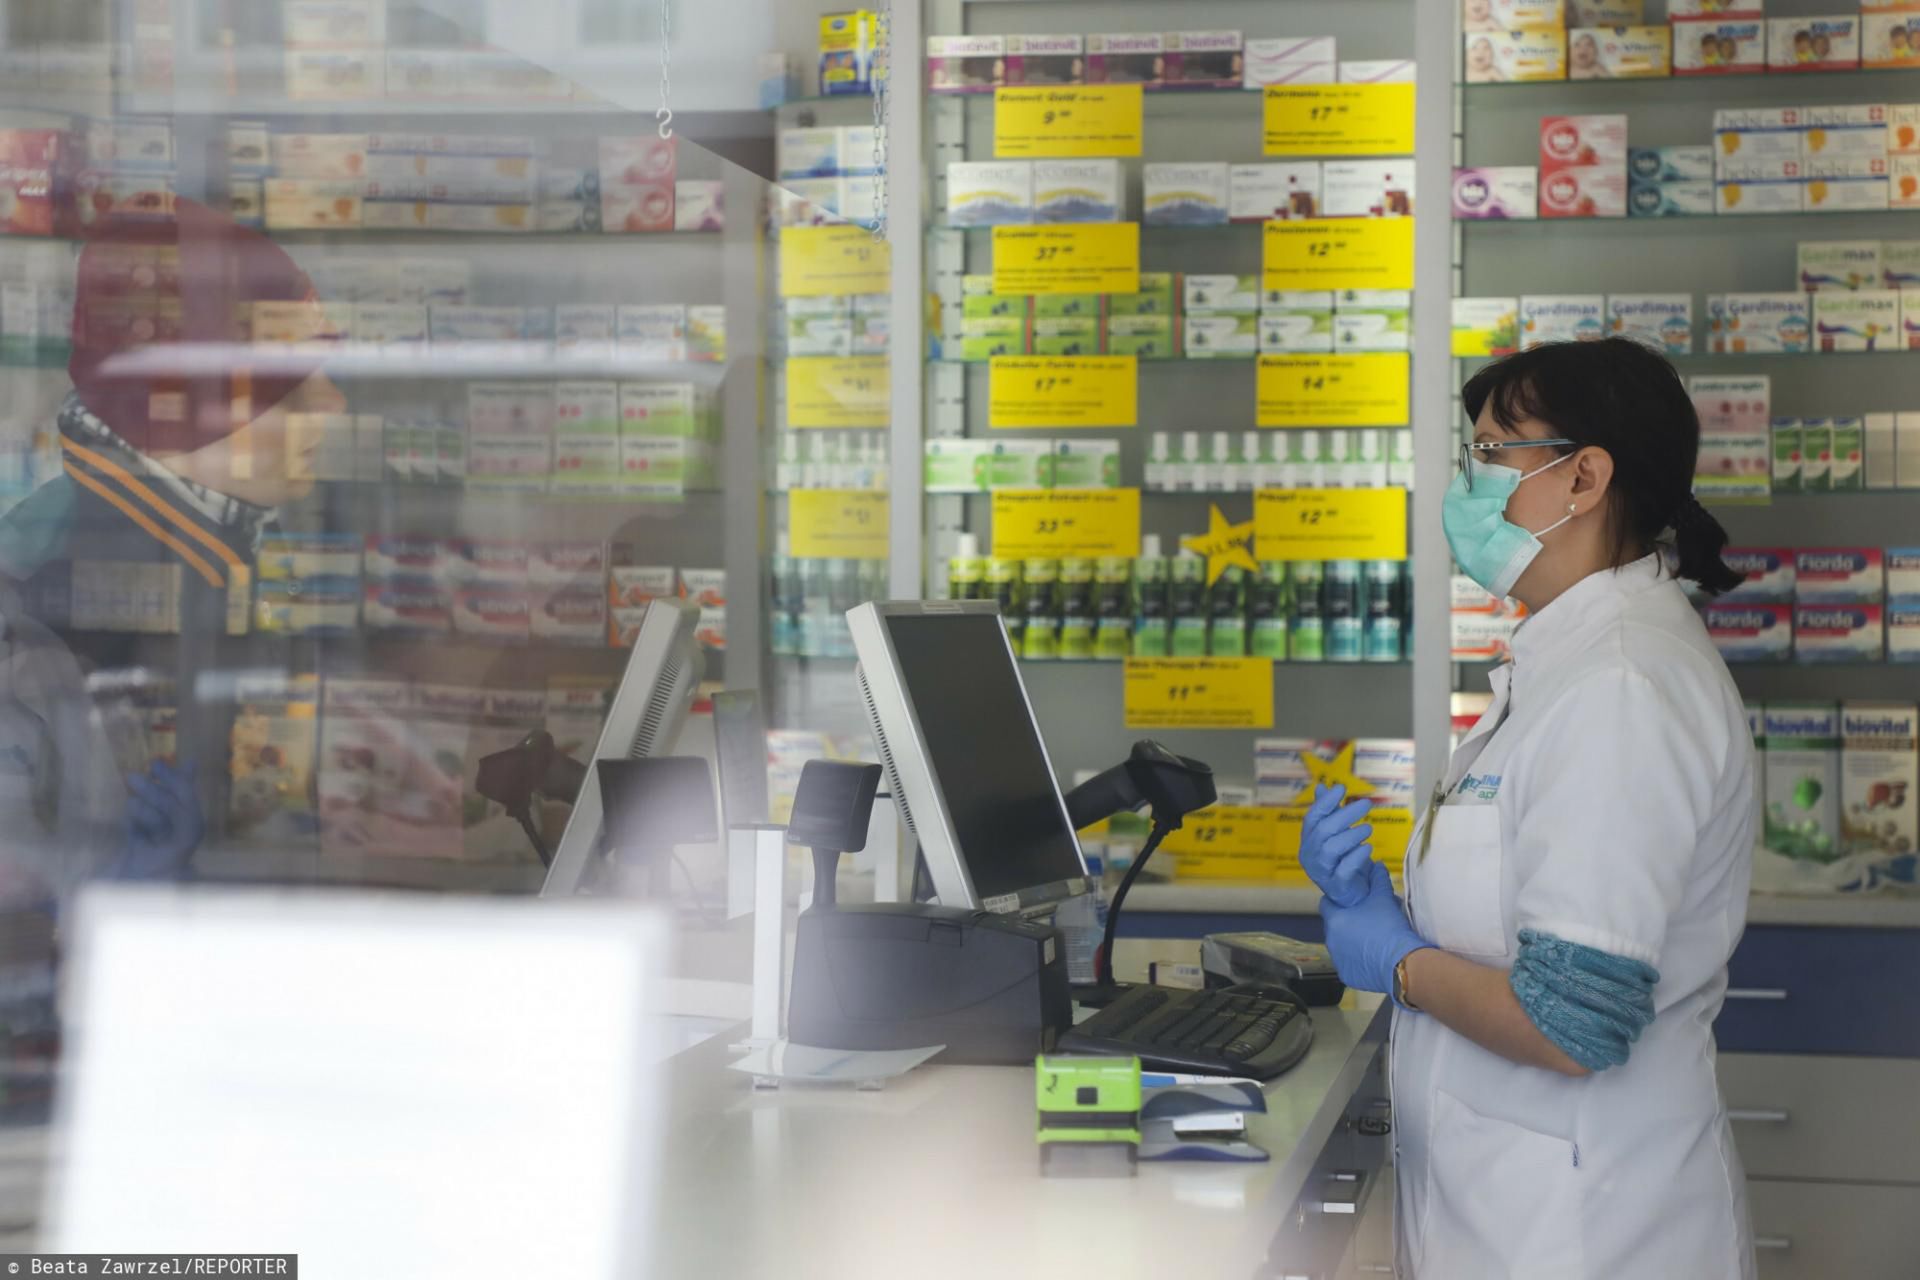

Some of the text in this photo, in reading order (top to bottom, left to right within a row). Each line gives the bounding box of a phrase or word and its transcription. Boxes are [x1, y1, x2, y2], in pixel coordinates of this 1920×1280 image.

[1310, 106, 1332, 120] 17
[1309, 241, 1330, 256] 12
[1611, 300, 1687, 316] Gardimax
[1728, 300, 1804, 316] Gardimax
[1035, 376, 1056, 391] 17
[1303, 377, 1324, 391] 14
[1299, 511, 1321, 525] 12
[1799, 553, 1855, 572] Fiorda
[1706, 609, 1765, 629] Fiorda
[1798, 609, 1854, 629] Fiorda
[1766, 714, 1832, 735] biovital
[1845, 716, 1911, 735] biovital
[1194, 827, 1216, 842] 12
